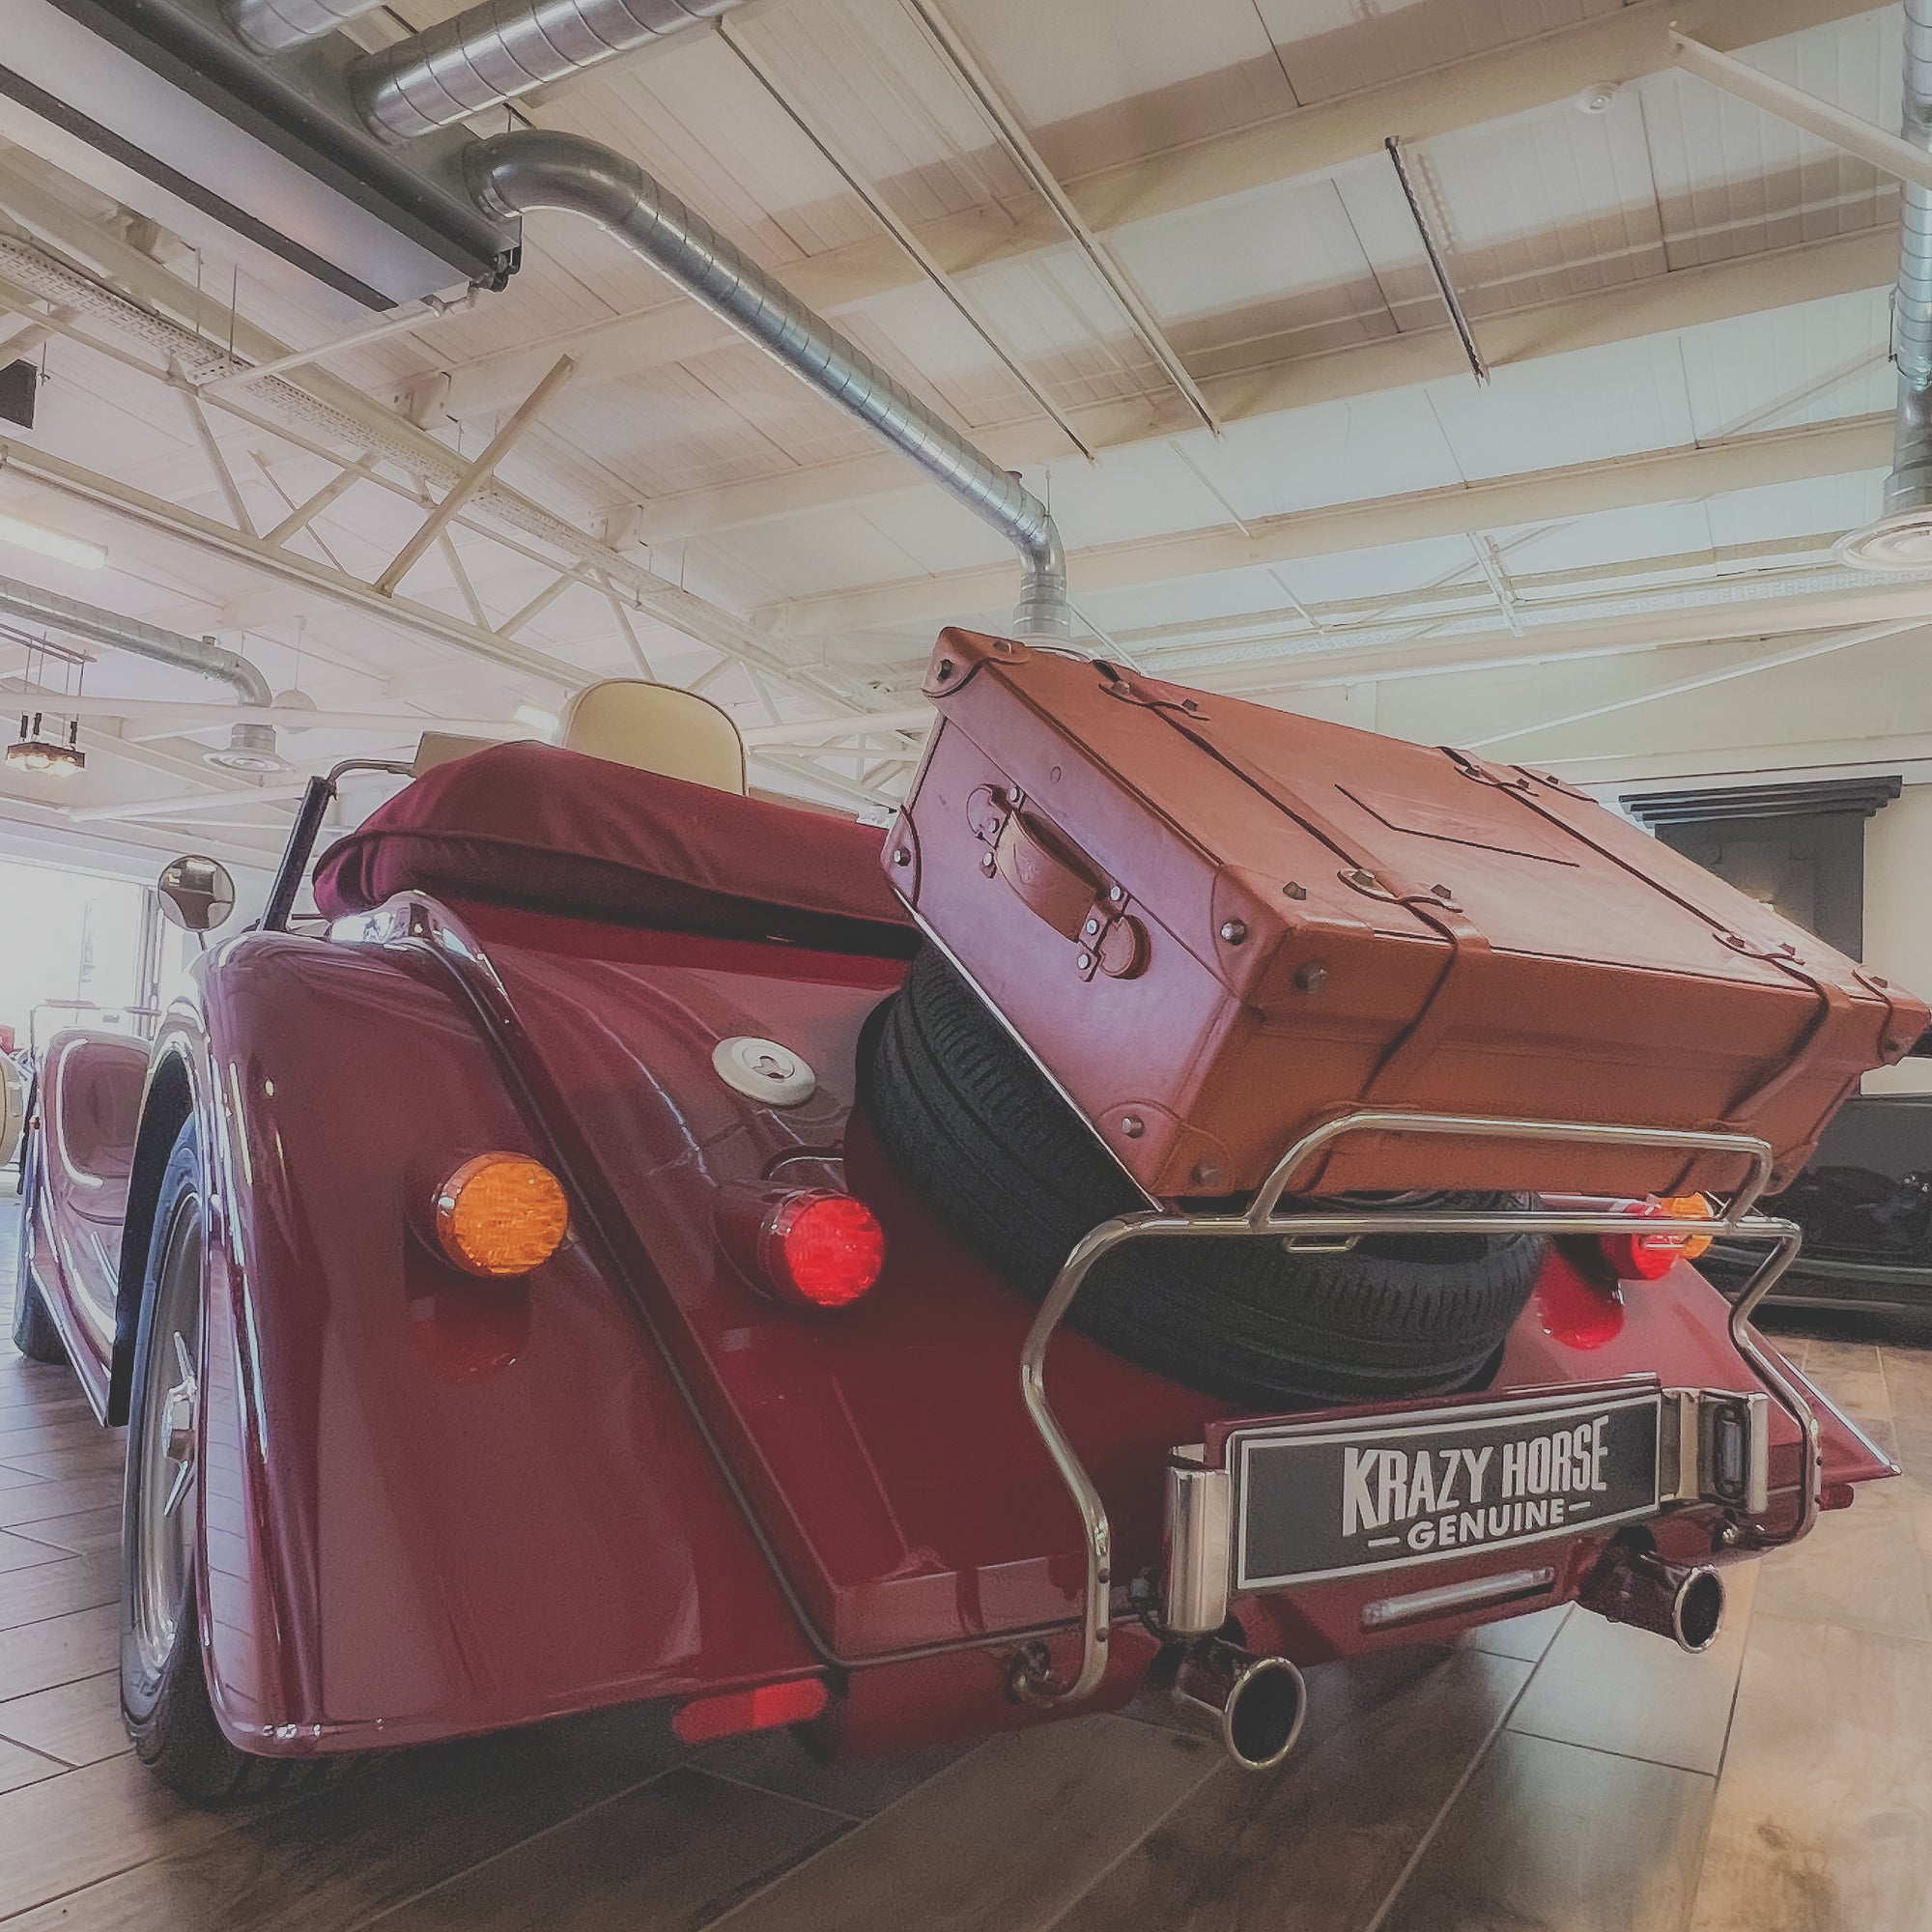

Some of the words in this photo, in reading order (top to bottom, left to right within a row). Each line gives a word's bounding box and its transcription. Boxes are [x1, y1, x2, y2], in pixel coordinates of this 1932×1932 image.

[1343, 1446, 1494, 1537] KRAZY
[1501, 1415, 1609, 1498] HORSE
[1406, 1498, 1565, 1550] GENUINE
